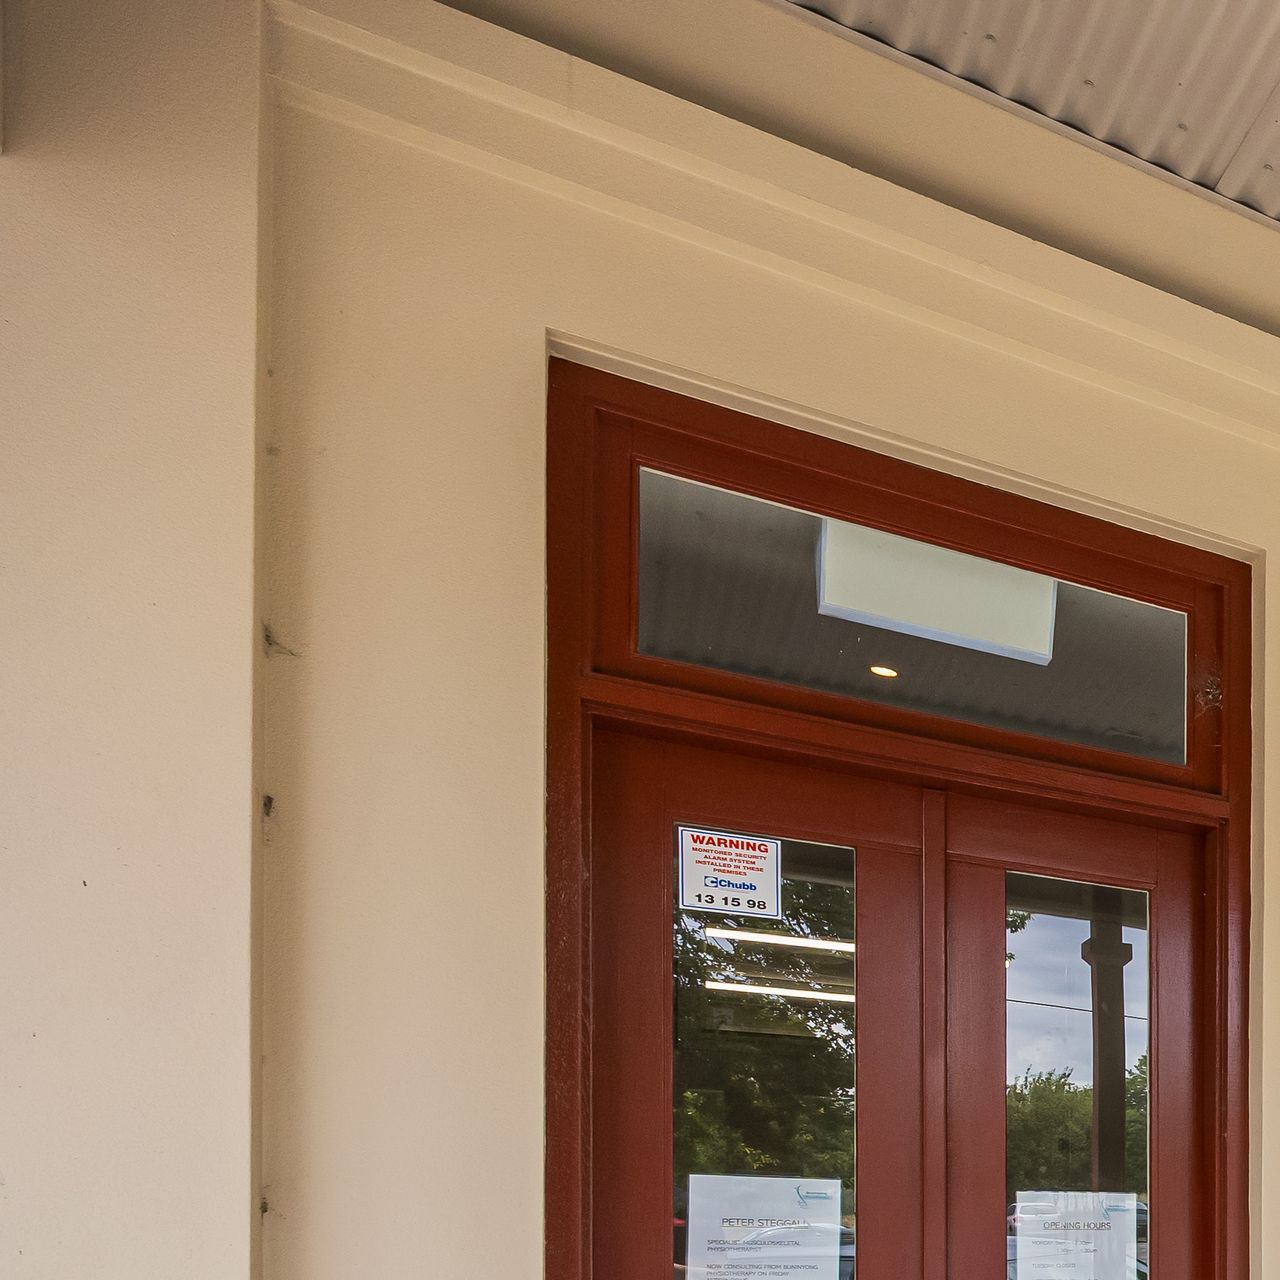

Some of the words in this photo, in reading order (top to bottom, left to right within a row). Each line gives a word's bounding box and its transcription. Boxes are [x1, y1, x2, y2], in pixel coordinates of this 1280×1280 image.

[691, 834, 768, 853] WARNING
[692, 847, 733, 856] MONITORED
[735, 852, 767, 860] SECURITY
[695, 860, 732, 868] INSTALLED
[713, 868, 747, 876] PREMISES
[719, 879, 757, 891] Chubb
[695, 893, 715, 904] 13
[721, 896, 741, 907] 15
[747, 899, 767, 910] 98
[721, 1218, 754, 1227] PETER
